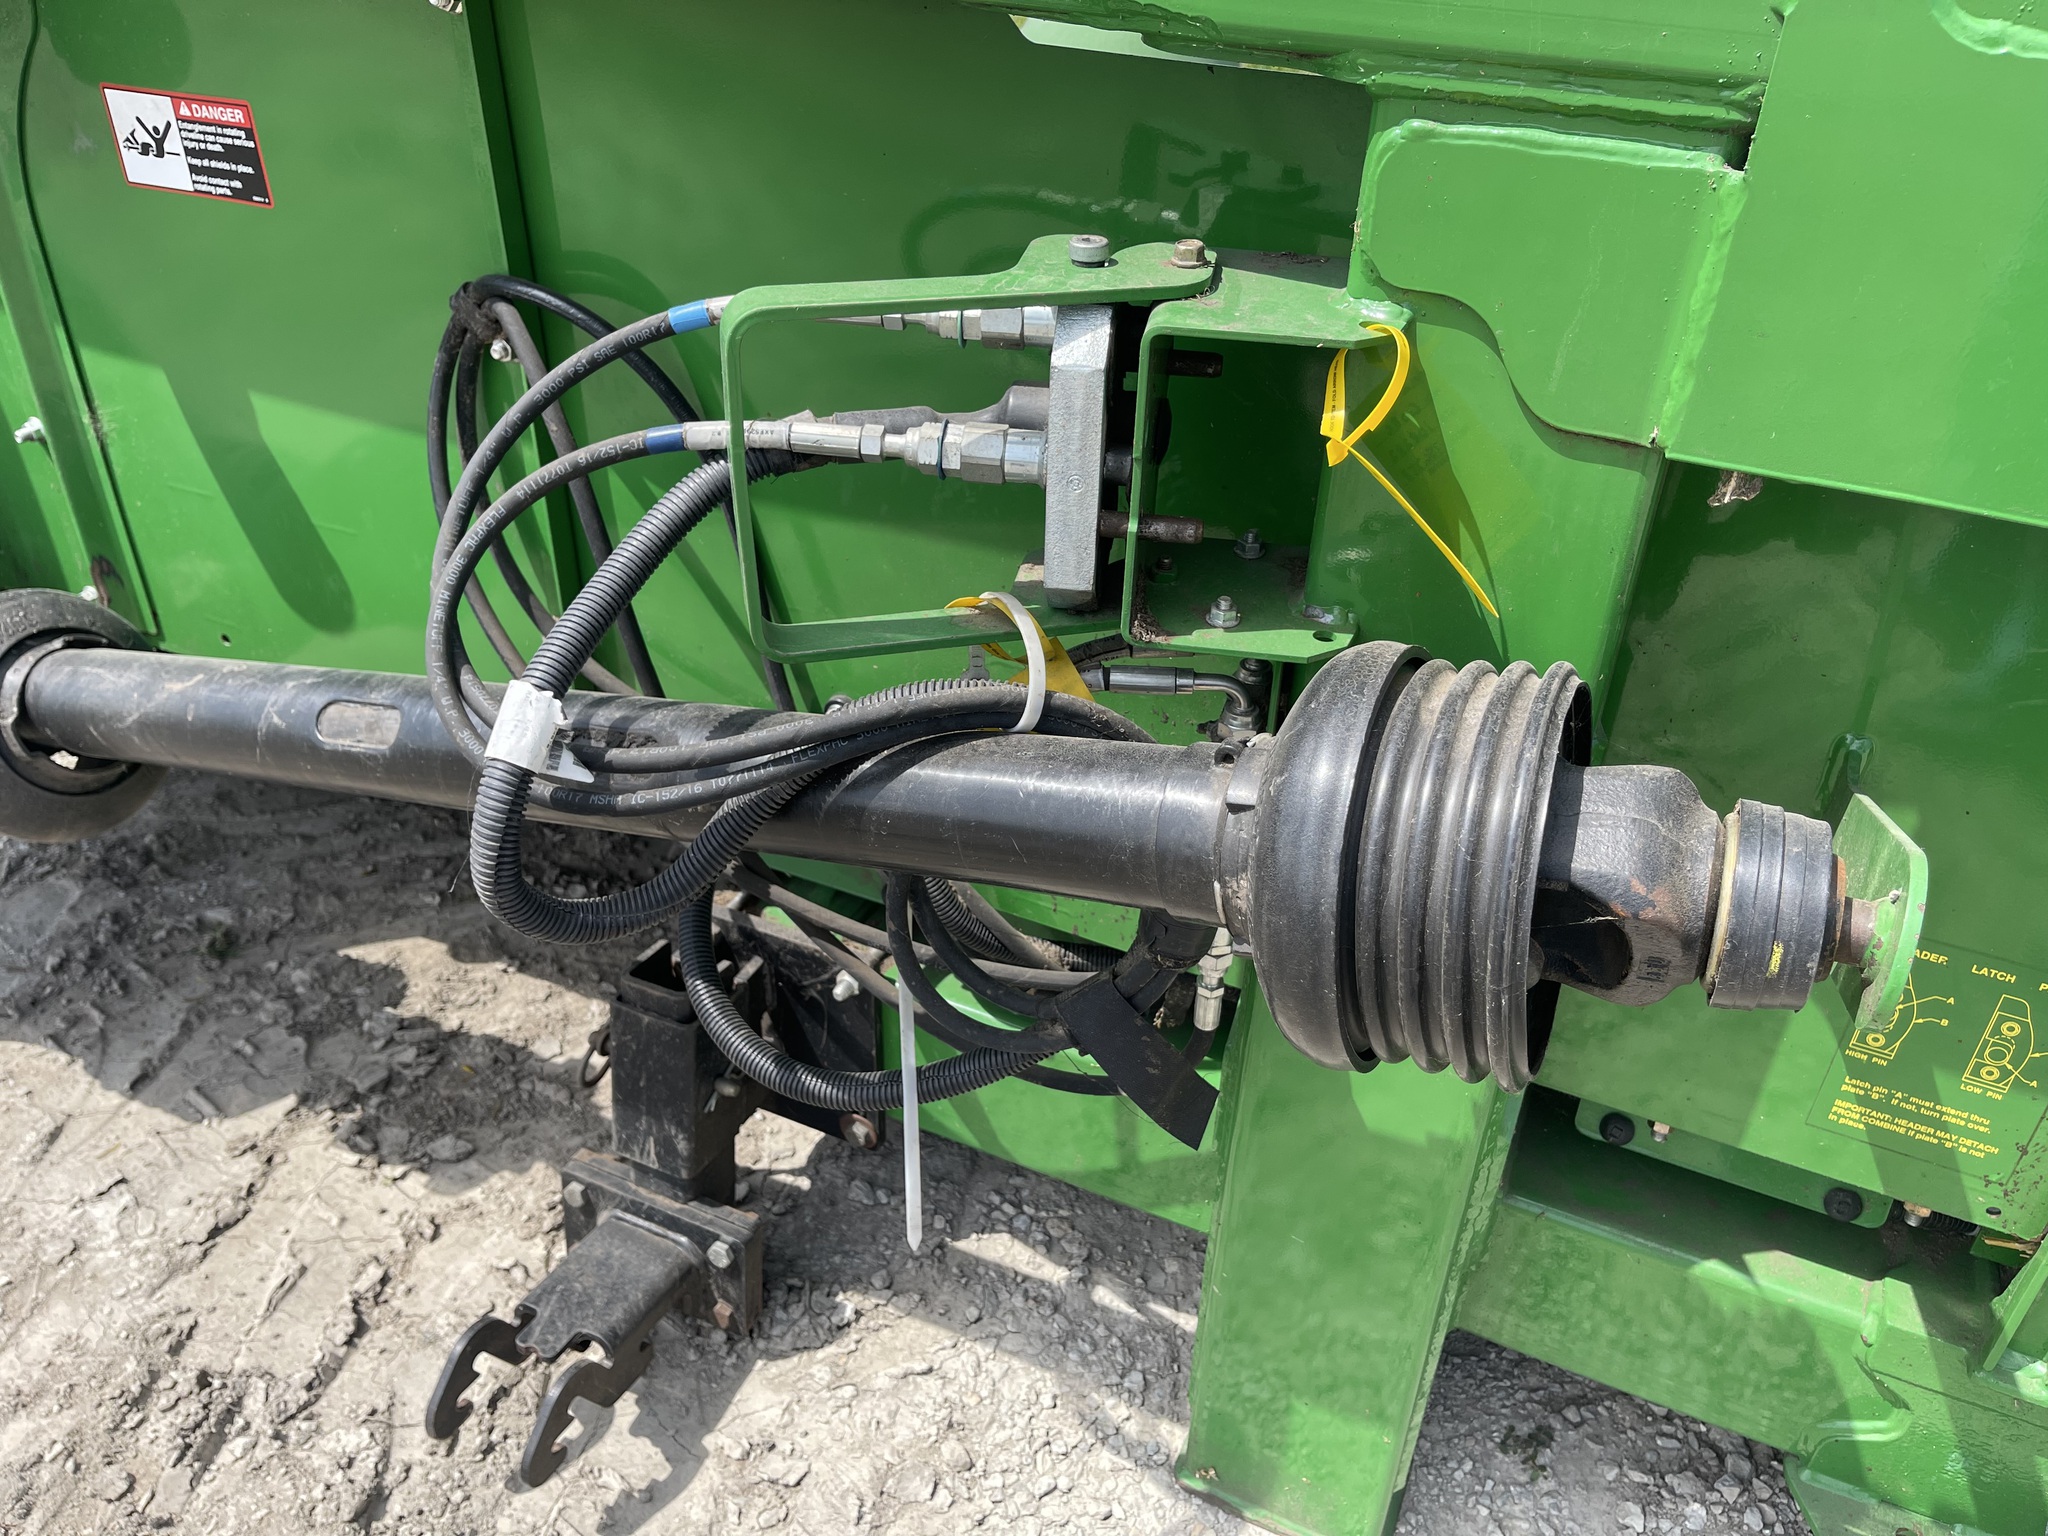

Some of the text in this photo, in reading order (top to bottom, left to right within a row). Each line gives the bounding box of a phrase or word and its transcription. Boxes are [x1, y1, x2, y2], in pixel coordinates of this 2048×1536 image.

[191, 104, 245, 124] DANGER
[533, 377, 565, 406] 3000
[567, 358, 590, 378] PSI
[593, 342, 618, 363] SAE
[622, 322, 667, 349] 100R17
[464, 504, 507, 553] FLEXPAC
[445, 554, 468, 585] 3000
[430, 589, 452, 652] MINETUFF
[458, 727, 485, 756] 3000
[790, 736, 850, 765] FLEXPAC
[1914, 948, 1949, 965] ADER
[1971, 964, 2017, 984] LATCH
[1946, 997, 1955, 1005] A
[1940, 1018, 1949, 1026] B
[1844, 1049, 1888, 1067] HIGH PIN
[1960, 1083, 2003, 1101] LOW PIN
[2029, 1080, 2038, 1088] A
[1840, 1084, 1865, 1096] plate
[1900, 1102, 1918, 1113] not,
[1920, 1107, 1940, 1119] turn
[1941, 1114, 1966, 1126] plate
[1967, 1122, 1991, 1134] over.
[1844, 1075, 1990, 1125] Latch pin "A" must extend thru
[1831, 1106, 1861, 1121] FROM
[1861, 1115, 1907, 1135] COMBINE
[1915, 1132, 1939, 1144] plate
[1969, 1148, 1985, 1159] not
[1834, 1098, 1999, 1154] IMPORTANT: HEADER MAY DETACH
[1838, 1117, 1866, 1131] place.
